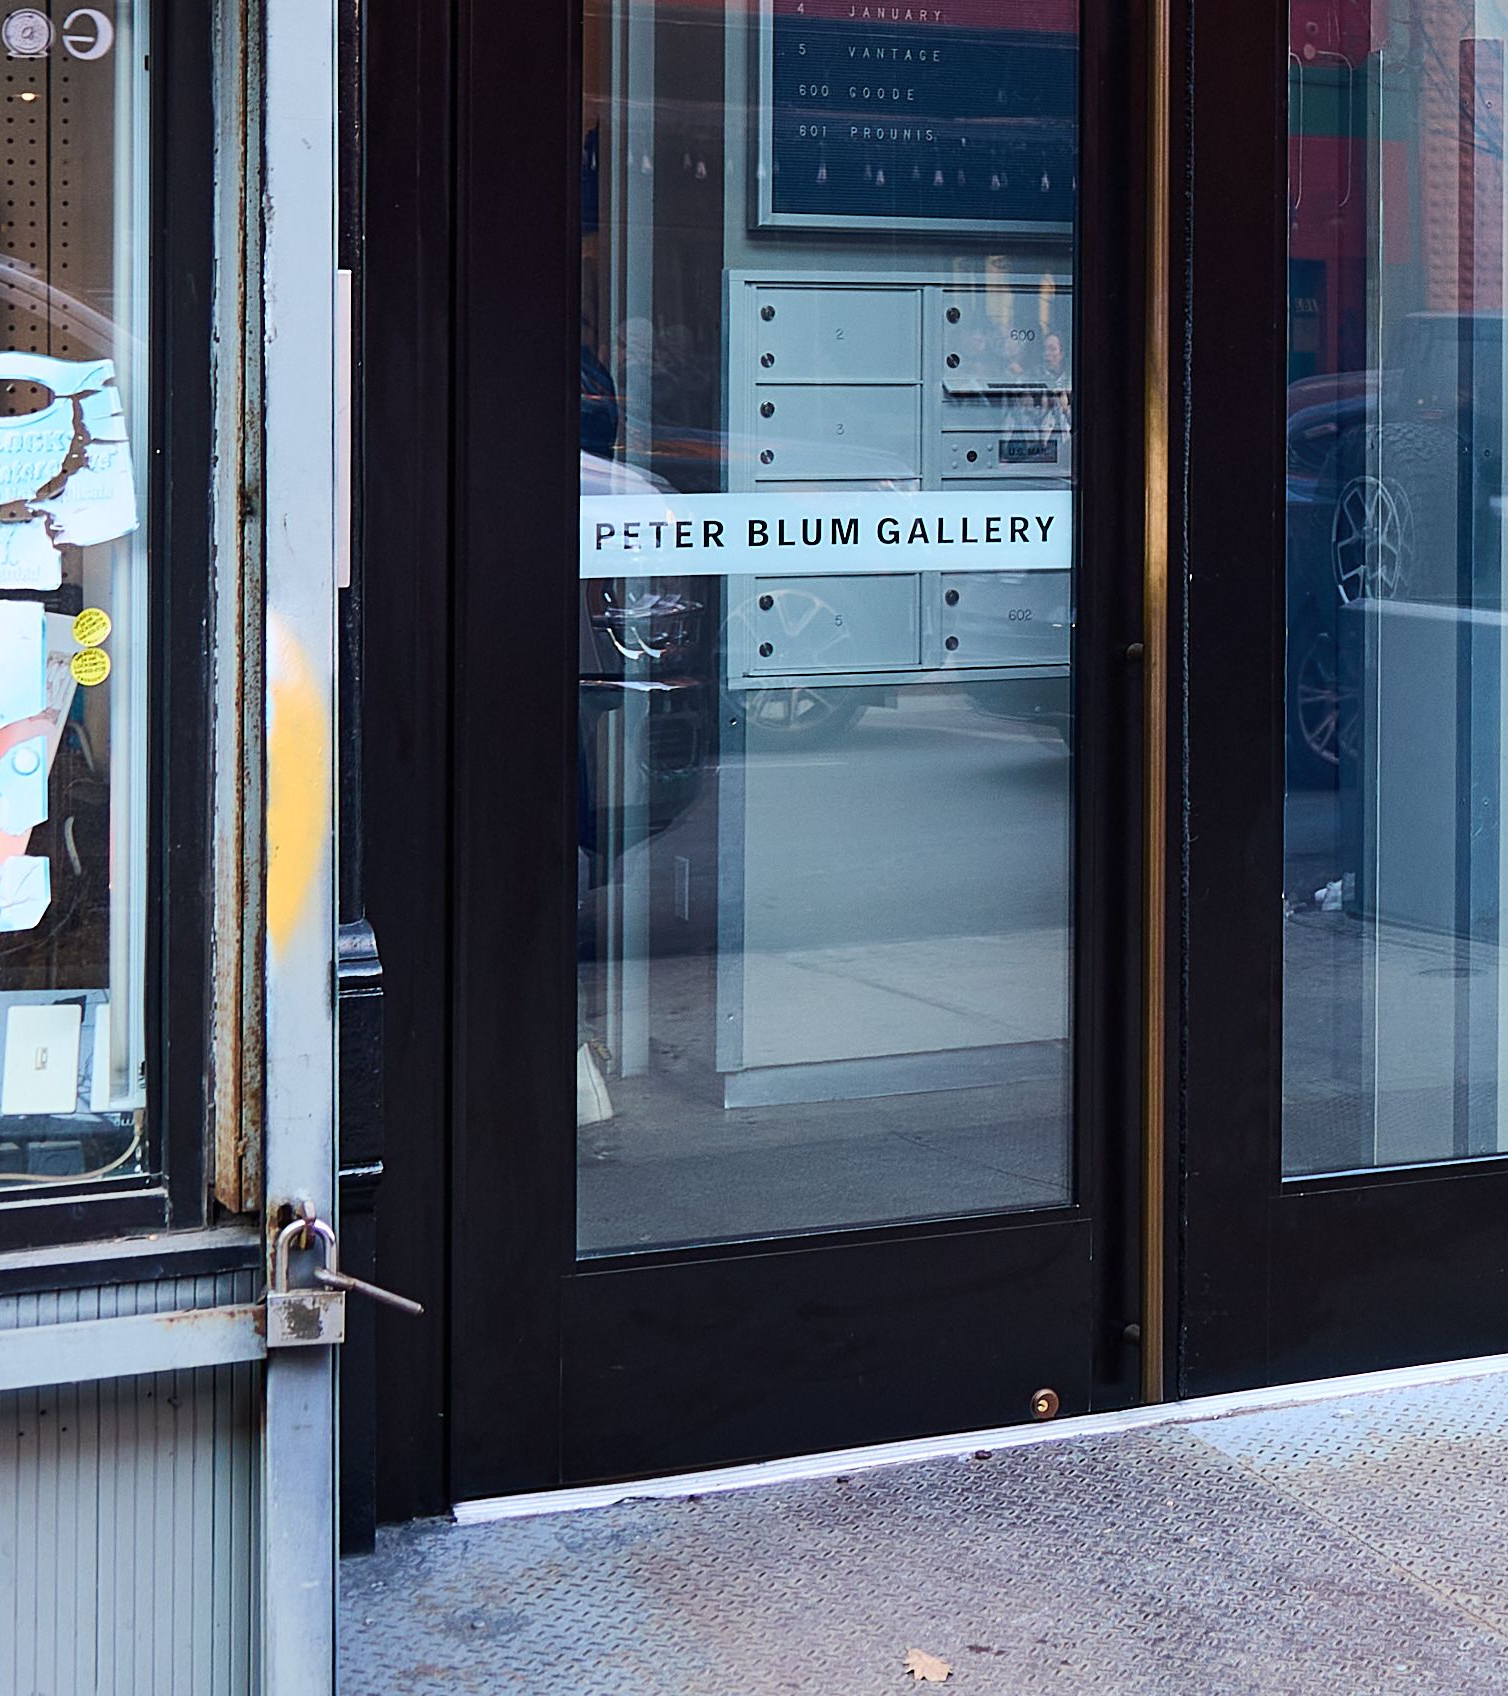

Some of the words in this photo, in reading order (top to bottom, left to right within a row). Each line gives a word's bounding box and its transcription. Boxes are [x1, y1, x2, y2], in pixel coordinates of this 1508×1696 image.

[797, 4, 805, 14] 4
[849, 6, 942, 22] JANUARY
[799, 44, 806, 55] 5
[848, 47, 941, 62] VANTAGE
[799, 85, 829, 97] 600
[799, 125, 827, 138] 601
[1010, 329, 1035, 342] 600
[595, 519, 725, 551] PETER
[747, 517, 860, 547] BLUM
[876, 515, 1056, 546] GALLERY
[1008, 609, 1032, 621] 602
